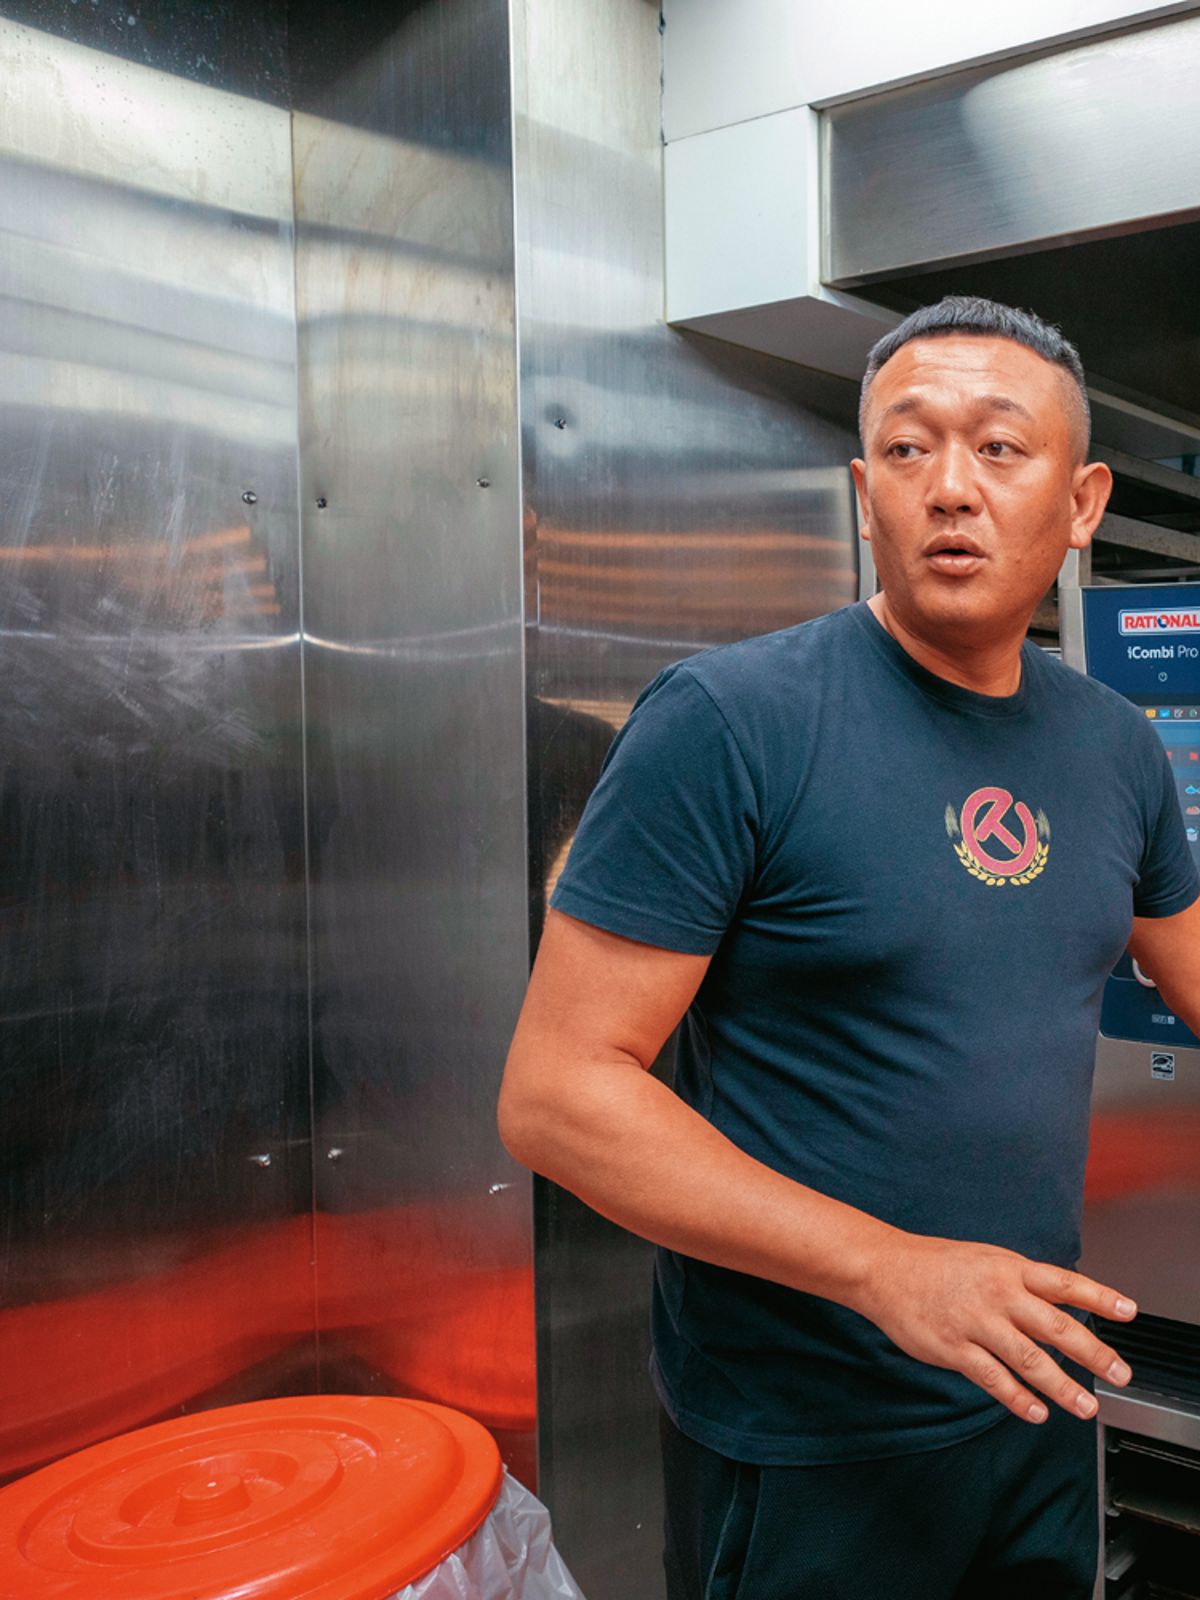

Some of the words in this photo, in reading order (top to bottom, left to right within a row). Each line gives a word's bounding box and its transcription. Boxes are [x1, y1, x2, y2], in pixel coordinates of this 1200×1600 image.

[1124, 613, 1200, 629] RATIONAL
[1127, 645, 1174, 659] iCombi
[1177, 644, 1199, 658] Pro
